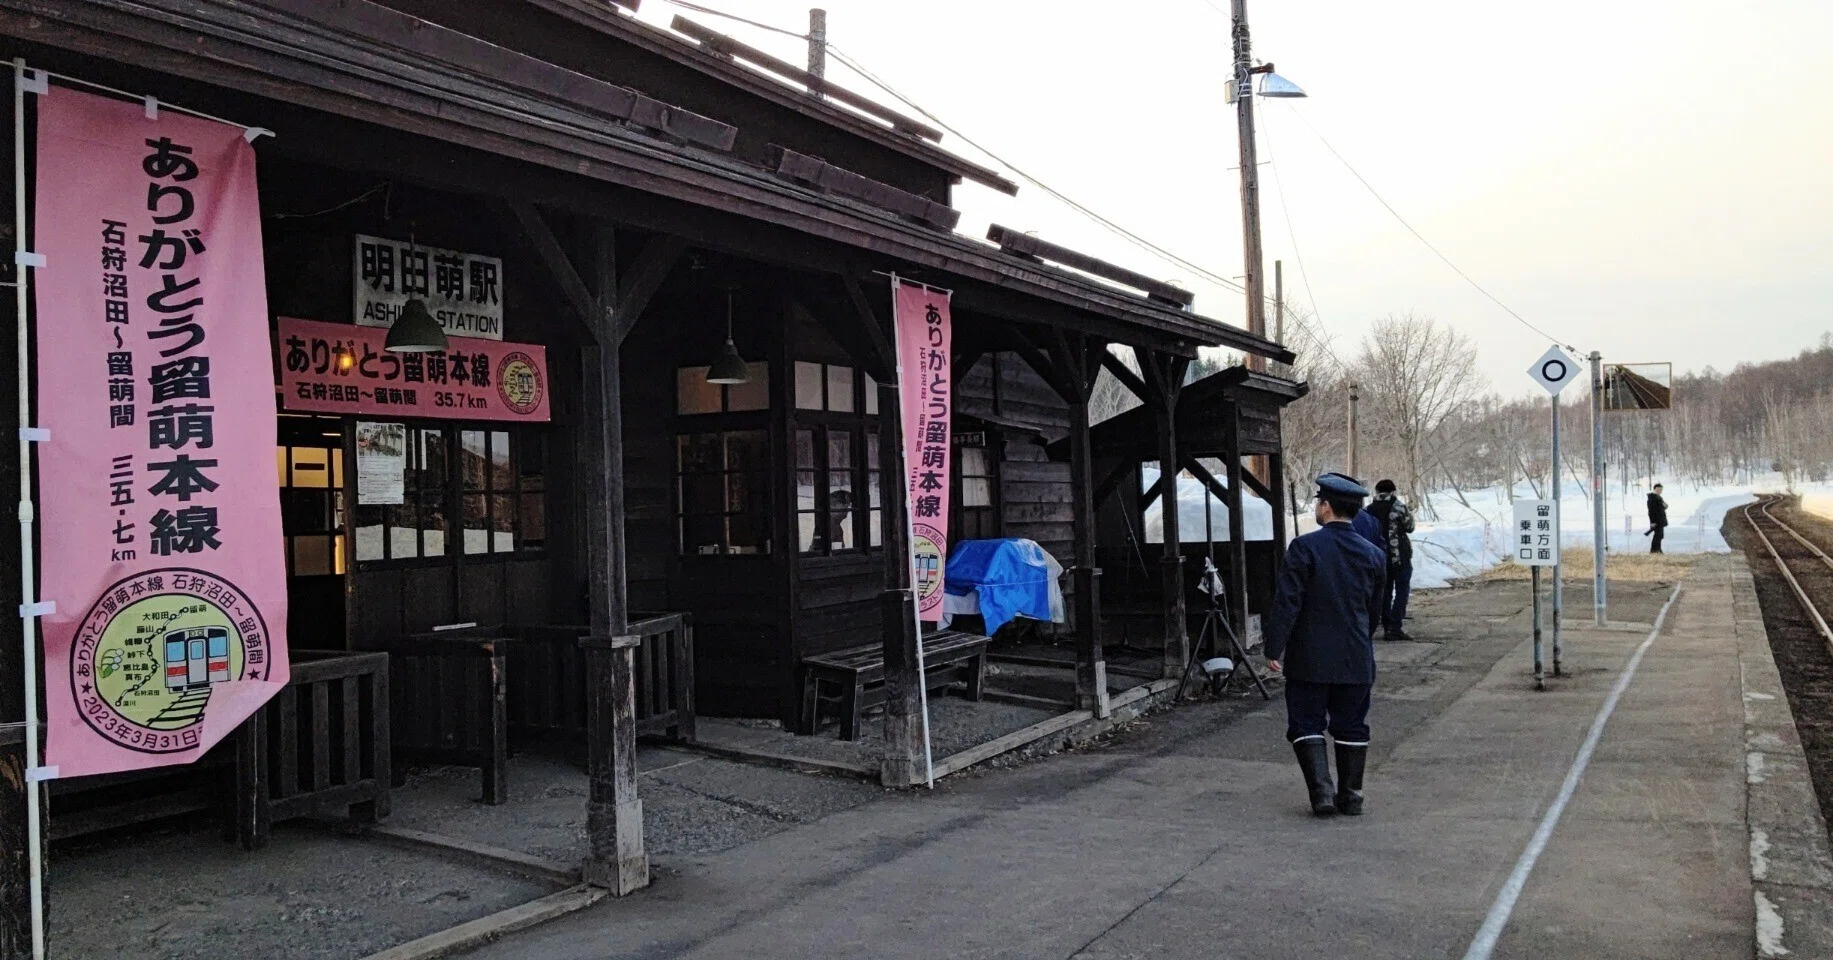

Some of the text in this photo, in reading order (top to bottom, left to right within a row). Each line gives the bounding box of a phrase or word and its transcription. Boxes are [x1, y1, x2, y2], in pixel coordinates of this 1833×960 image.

[101, 218, 135, 428] 石狩沼田～留萌間
[363, 300, 499, 334] ASHI STATION
[139, 136, 222, 556] ありがとう留萌本線
[286, 335, 491, 387] ありがとう留萌本線
[295, 381, 417, 406] 石狩沼田～留萌間
[915, 303, 947, 518] ありがとう留萌本線
[1520, 519, 1532, 560] 乗車口
[1536, 504, 1550, 560] 留萌方面
[77, 574, 264, 677] ありがとう留萌本線 石狩沼田～留萌間
[142, 611, 169, 621] 大和田
[190, 604, 207, 614] 留萌
[83, 696, 203, 749] 2023年3月31日
